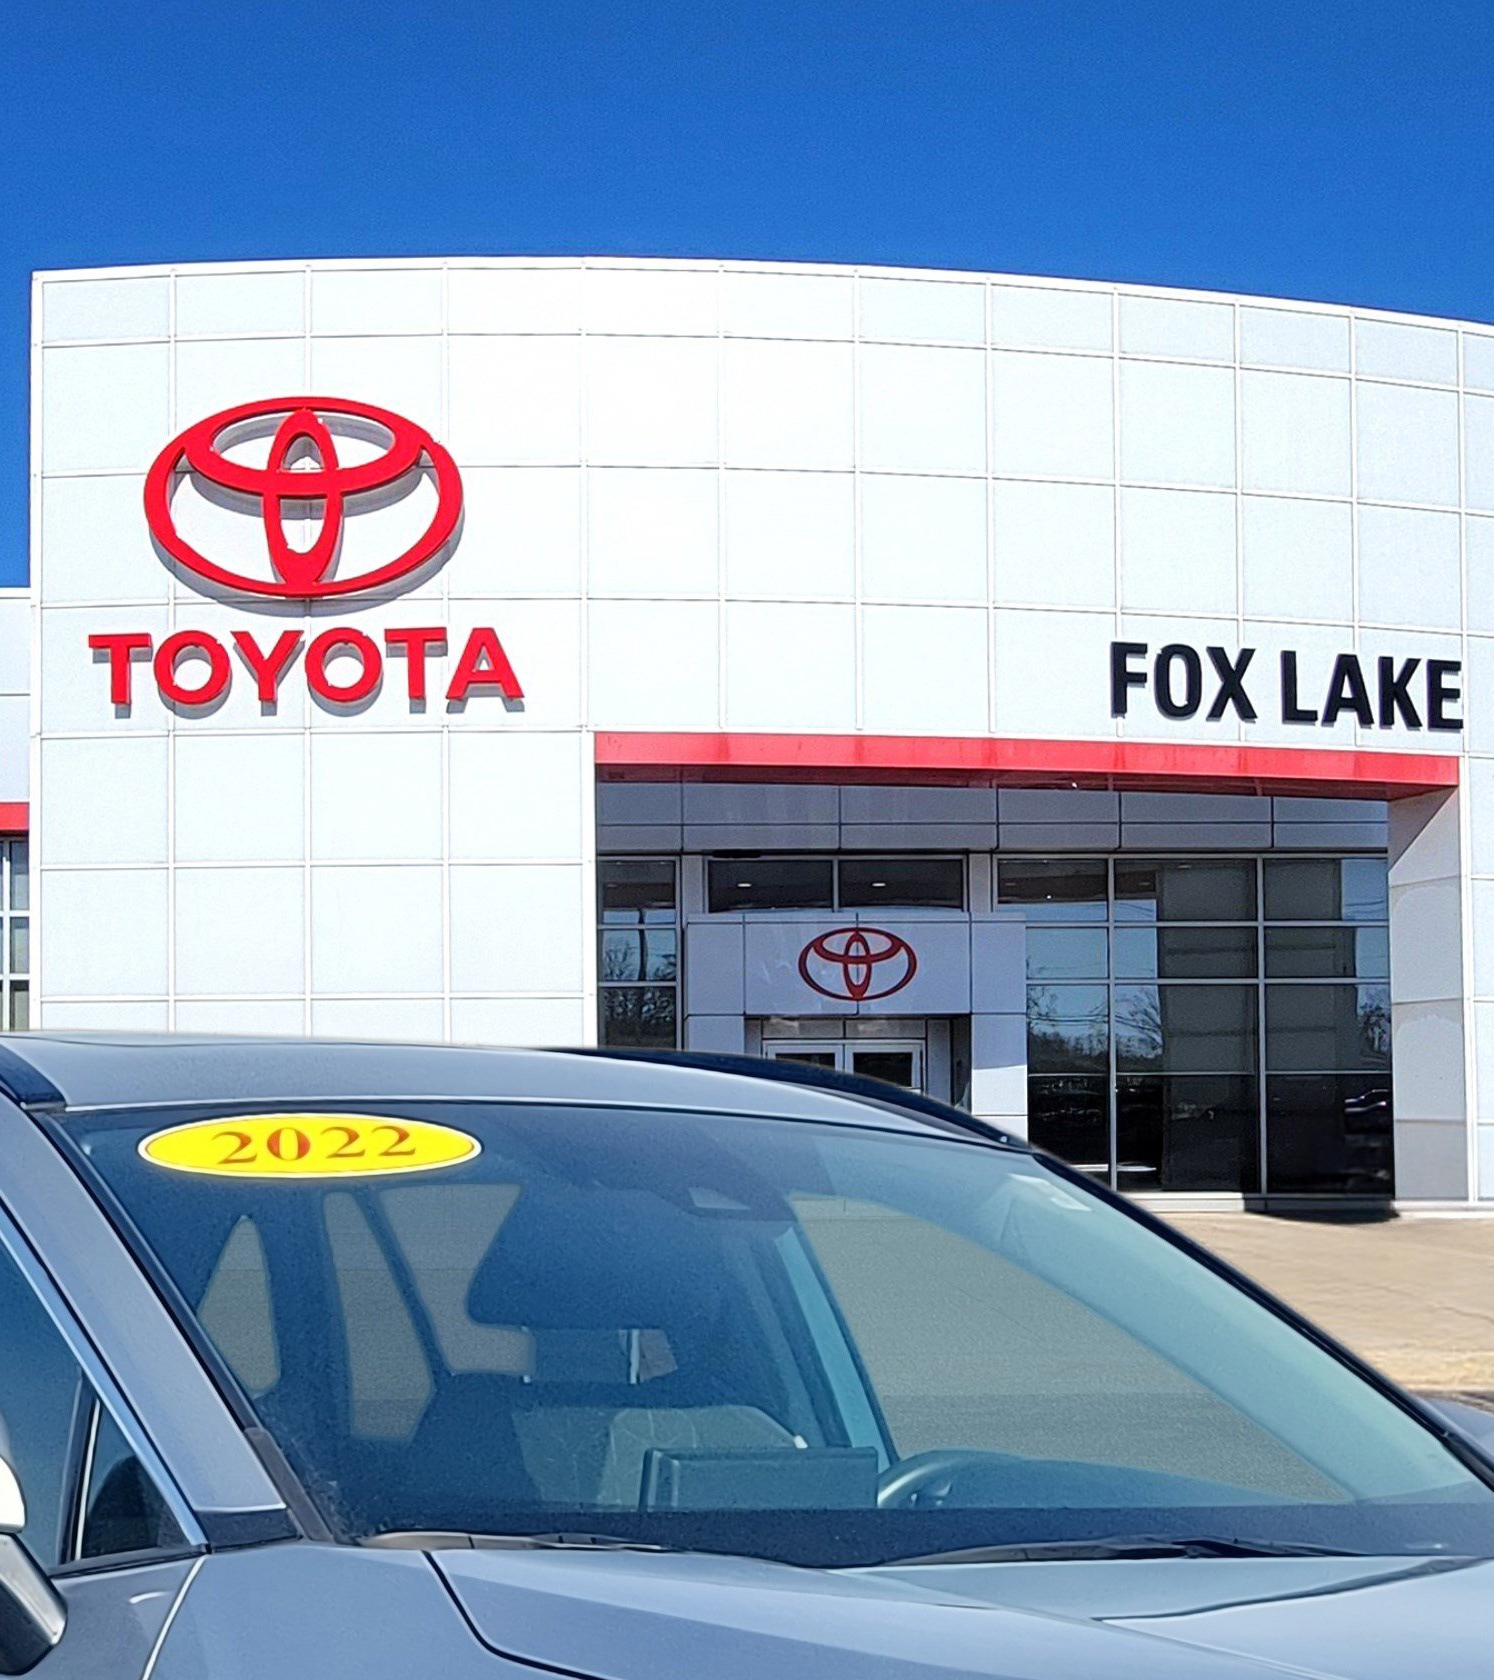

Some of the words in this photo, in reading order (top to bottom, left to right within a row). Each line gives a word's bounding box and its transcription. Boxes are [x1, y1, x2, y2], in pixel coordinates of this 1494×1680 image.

[88, 626, 526, 710] TOYOTA
[1110, 641, 1258, 722] FOX
[1280, 649, 1465, 731] LAKE
[212, 1124, 417, 1166] 2022
